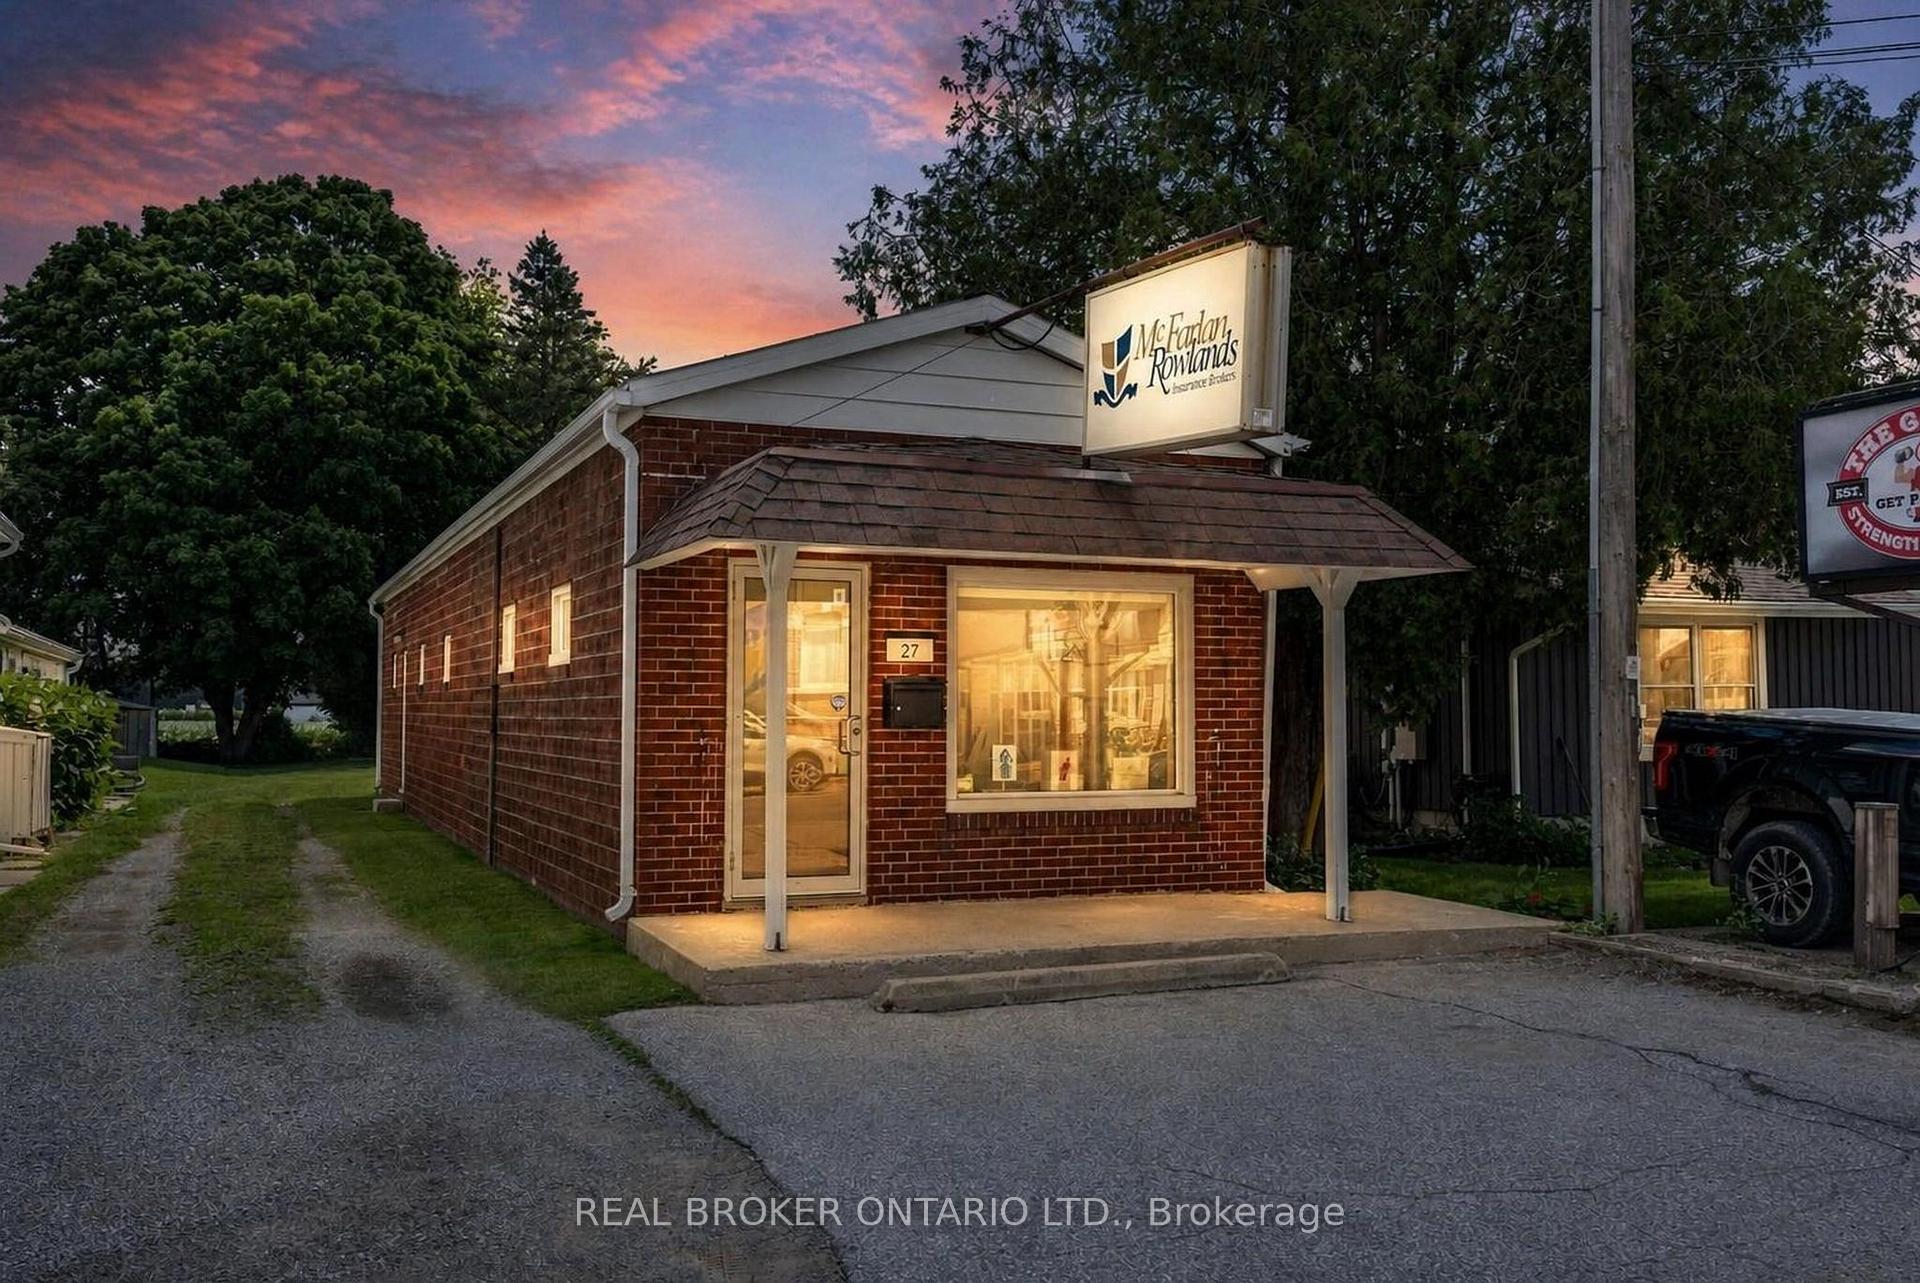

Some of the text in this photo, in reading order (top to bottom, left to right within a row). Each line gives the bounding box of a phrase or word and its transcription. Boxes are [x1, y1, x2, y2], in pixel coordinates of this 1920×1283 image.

[1146, 329, 1239, 395] Rowlands
[1844, 421, 1895, 474] THE
[1835, 486, 1864, 500] EST.
[1876, 495, 1905, 509] GET
[901, 643, 920, 659] 27
